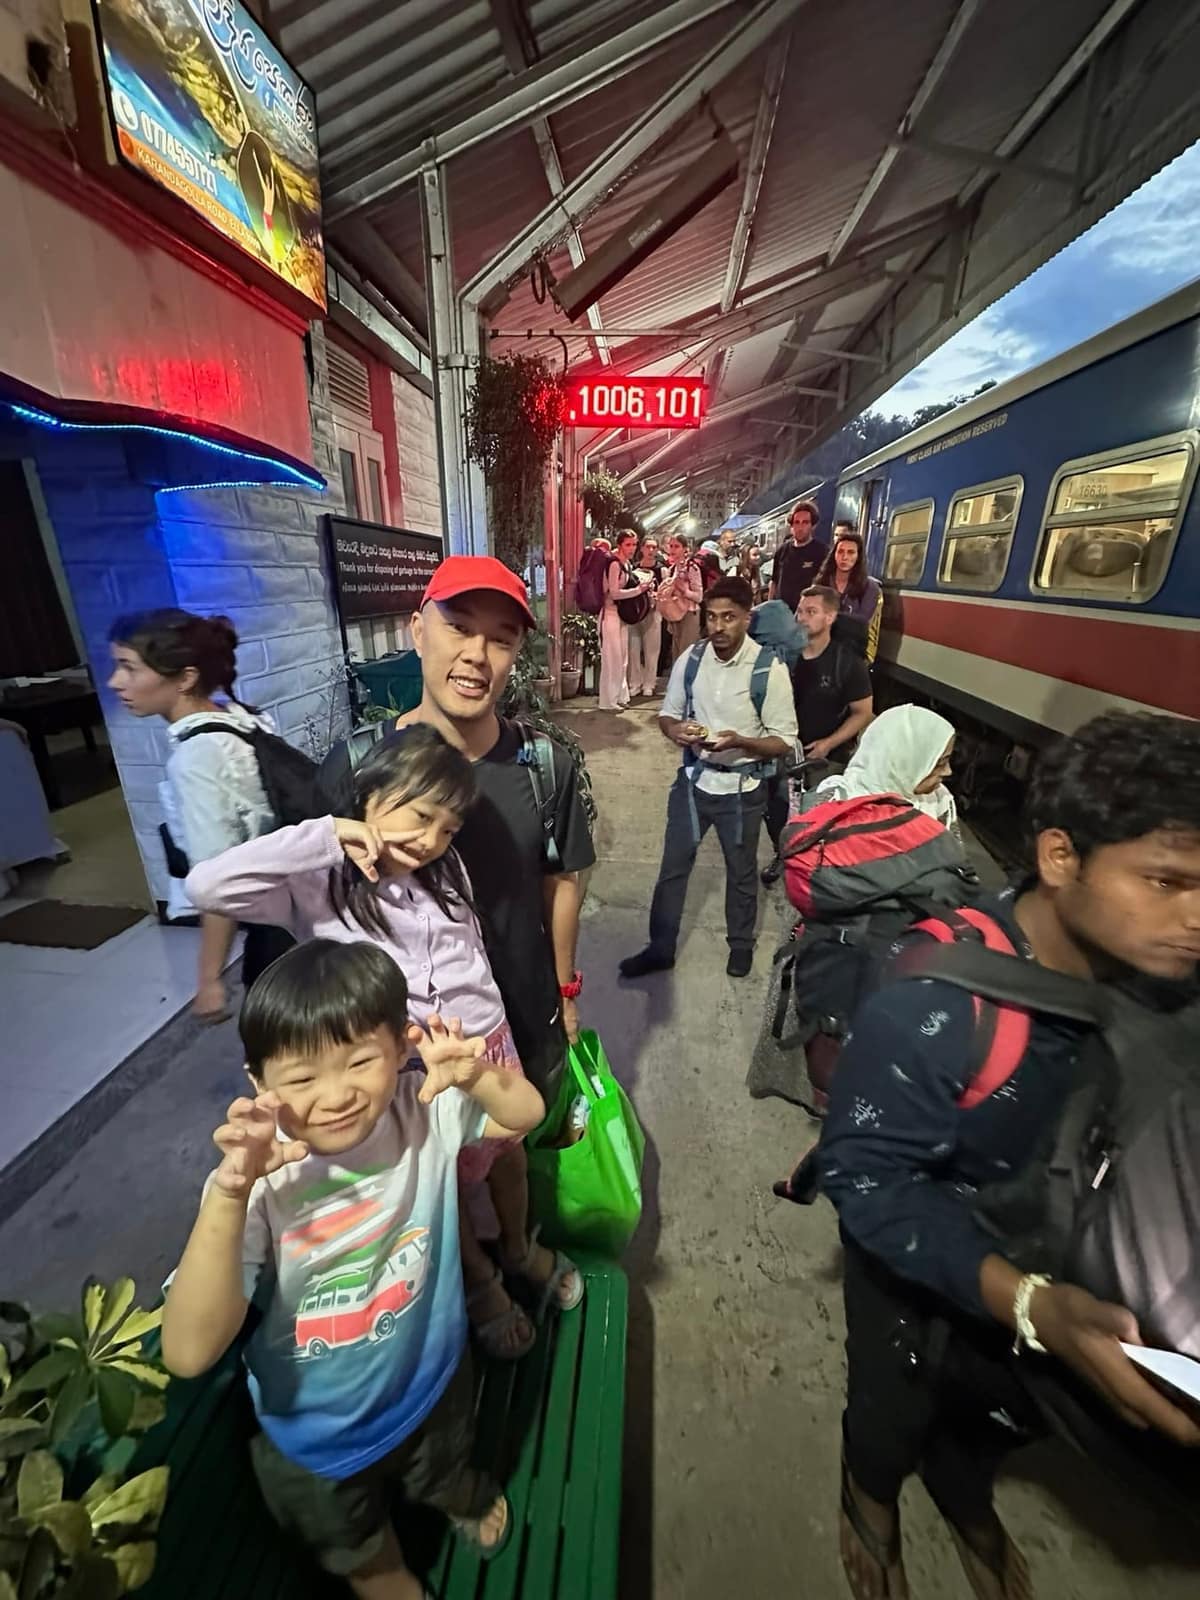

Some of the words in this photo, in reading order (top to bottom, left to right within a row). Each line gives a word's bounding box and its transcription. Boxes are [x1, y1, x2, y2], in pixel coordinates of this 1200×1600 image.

[918, 446, 933, 460] CLASS
[942, 429, 972, 450] CONDITION
[972, 412, 1009, 438] RESERVED
[339, 561, 356, 572] Thank
[357, 564, 367, 575] you
[366, 563, 374, 573] for
[374, 563, 394, 576] disposing
[398, 565, 413, 577] garbage
